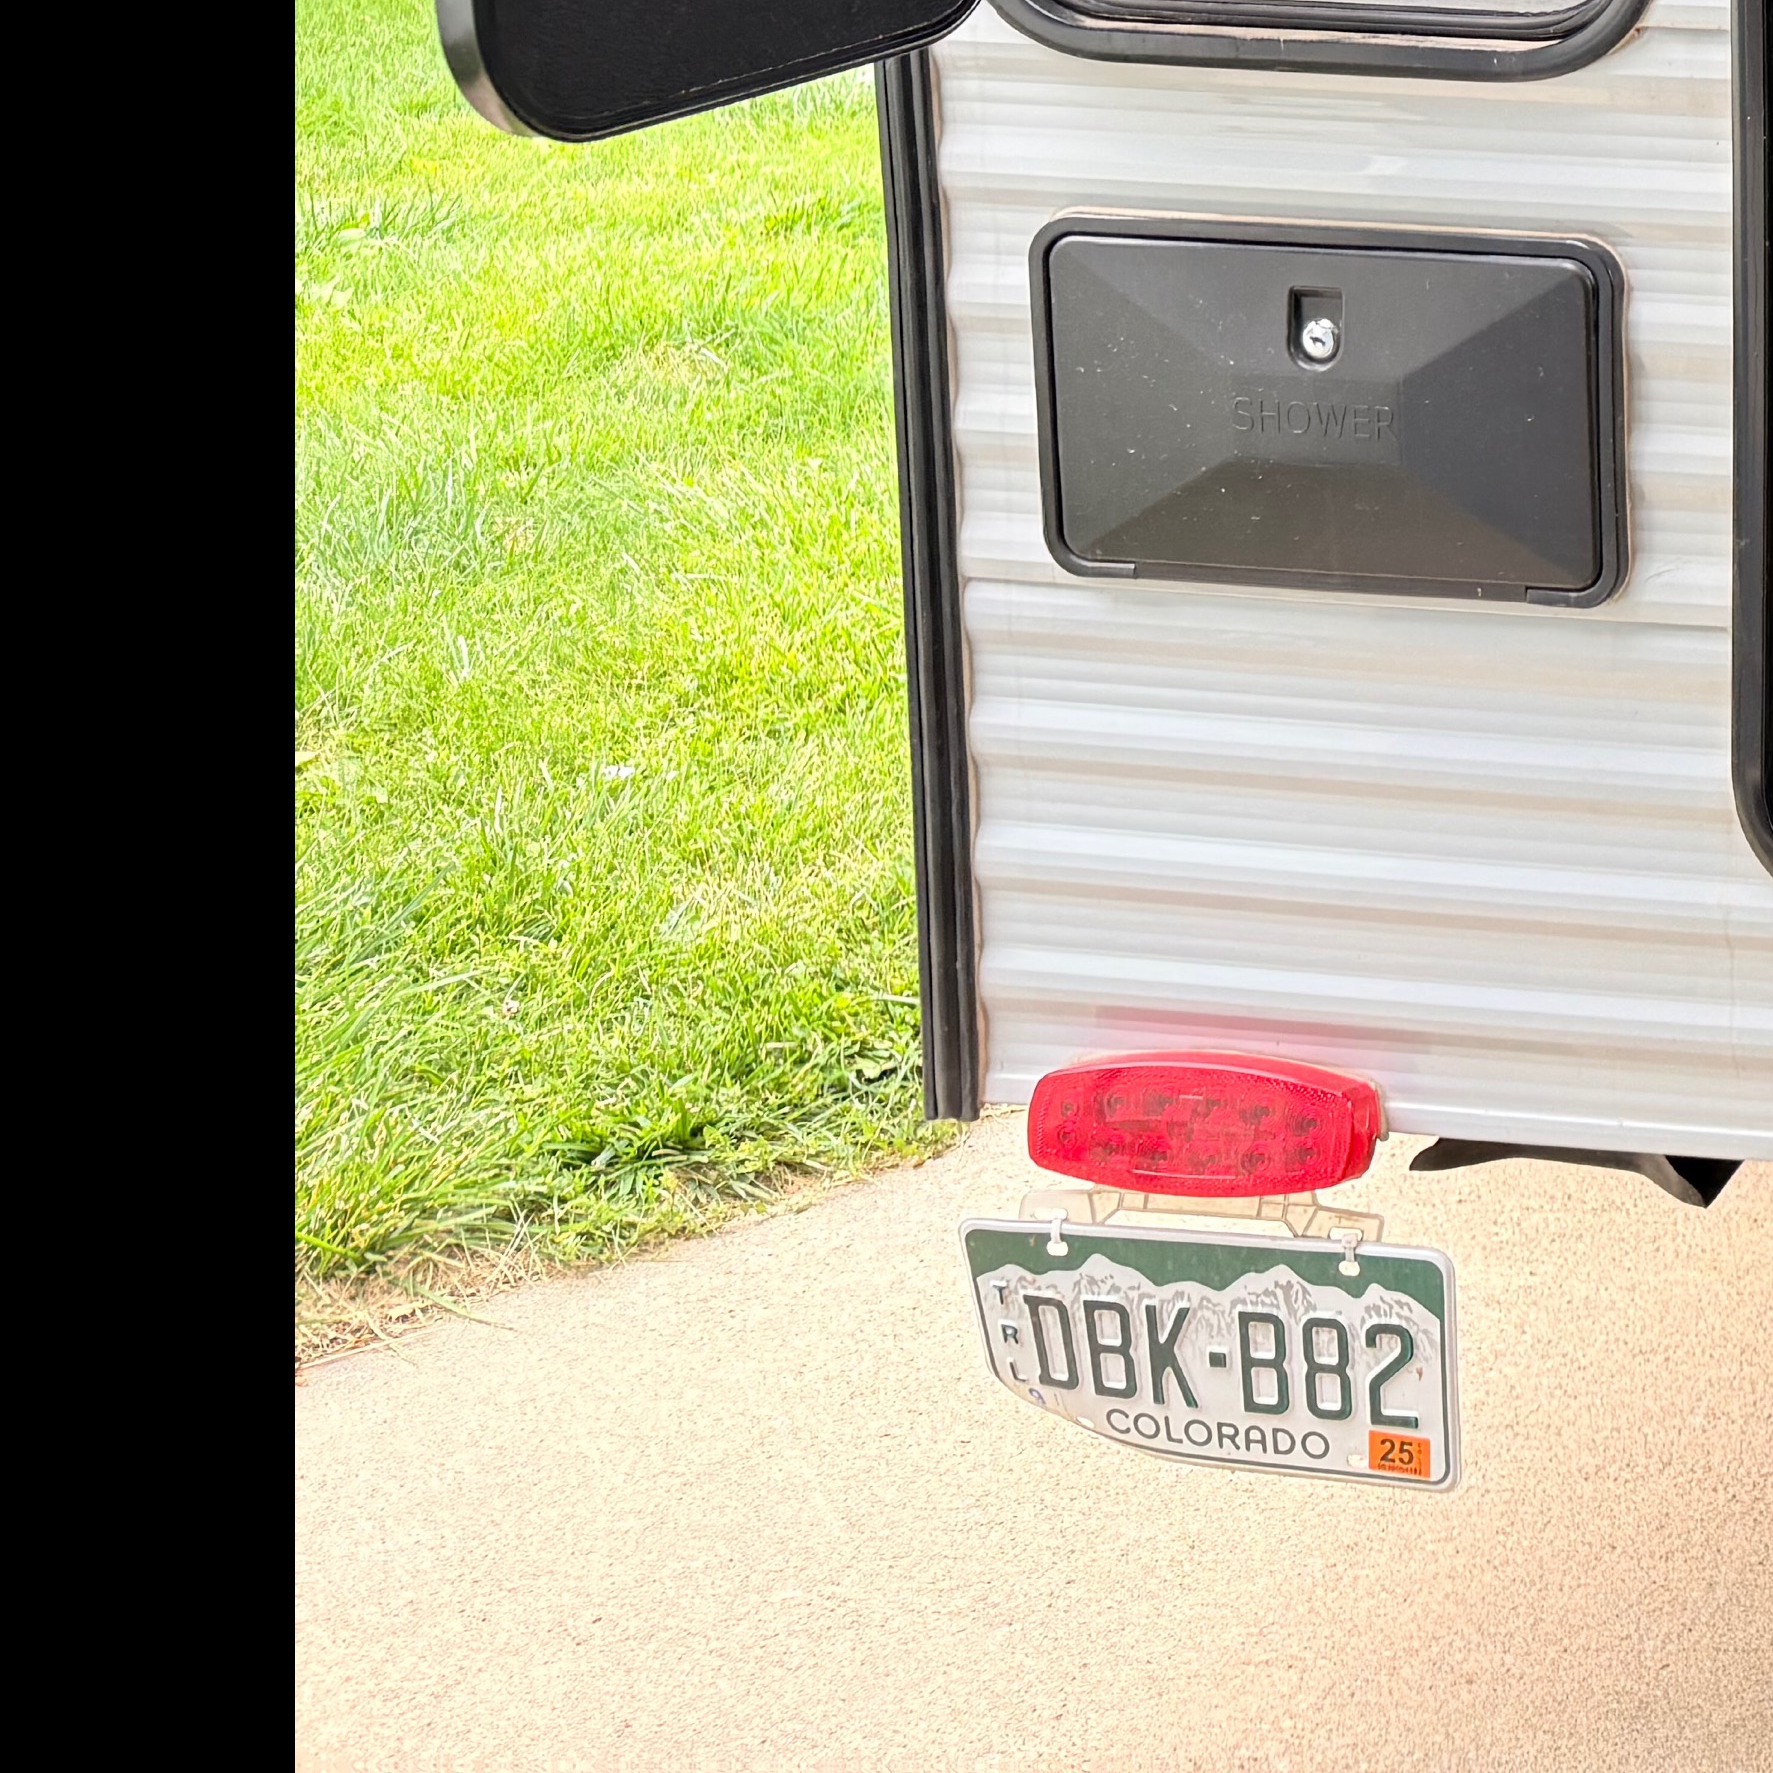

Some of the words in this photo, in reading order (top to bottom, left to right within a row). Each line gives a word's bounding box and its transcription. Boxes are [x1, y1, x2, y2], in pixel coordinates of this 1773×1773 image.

[1233, 396, 1397, 442] SHOWER
[1106, 1408, 1330, 1460] COLORADO
[1380, 1438, 1414, 1465] 25
